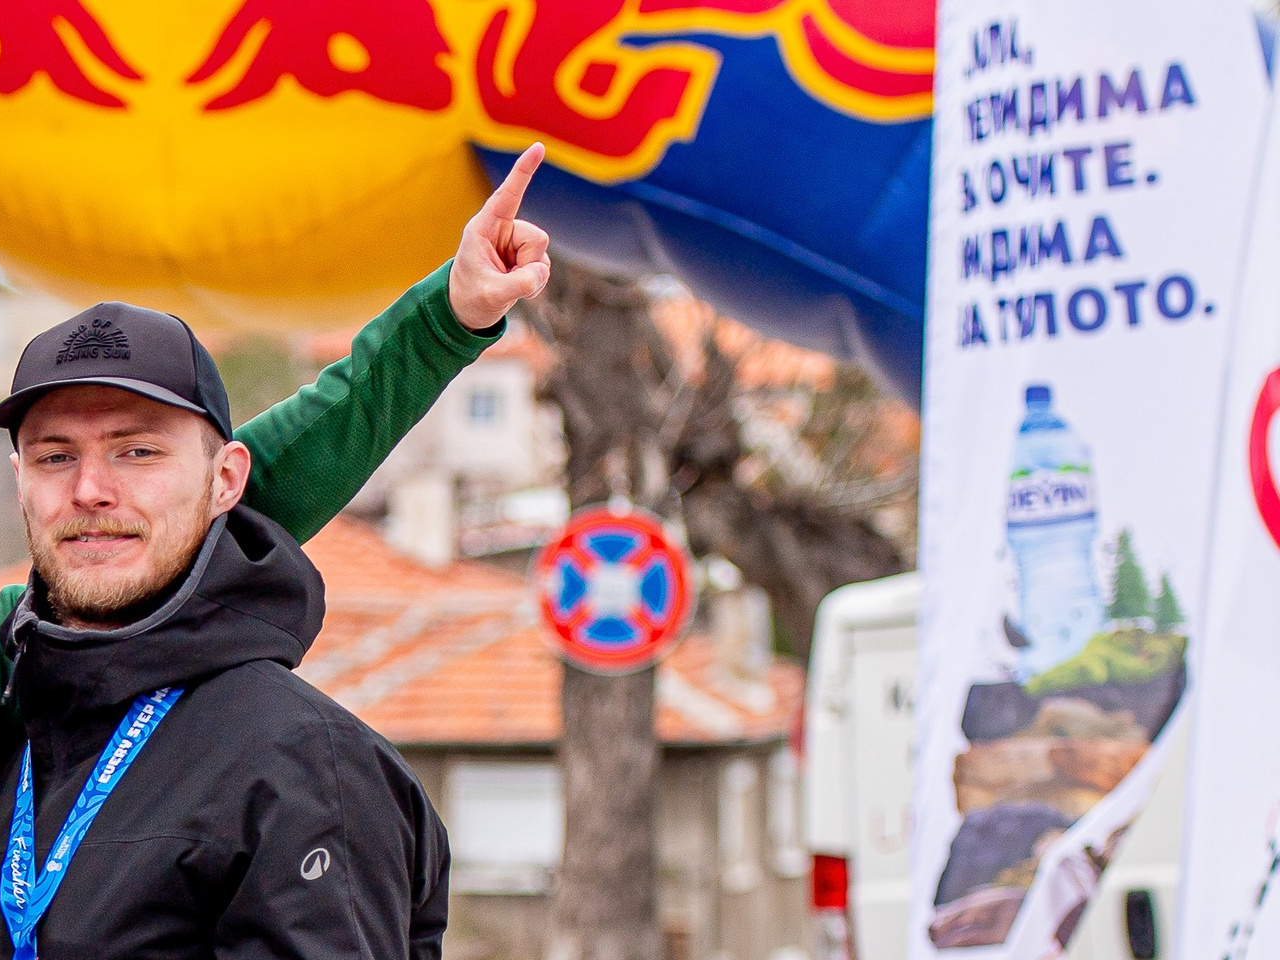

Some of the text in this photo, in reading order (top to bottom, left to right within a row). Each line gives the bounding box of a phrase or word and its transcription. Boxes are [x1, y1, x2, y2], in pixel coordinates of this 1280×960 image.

[91, 319, 112, 329] OF
[102, 346, 131, 361] SUN
[126, 703, 155, 738] STEP
[11, 835, 32, 910] Finisher
